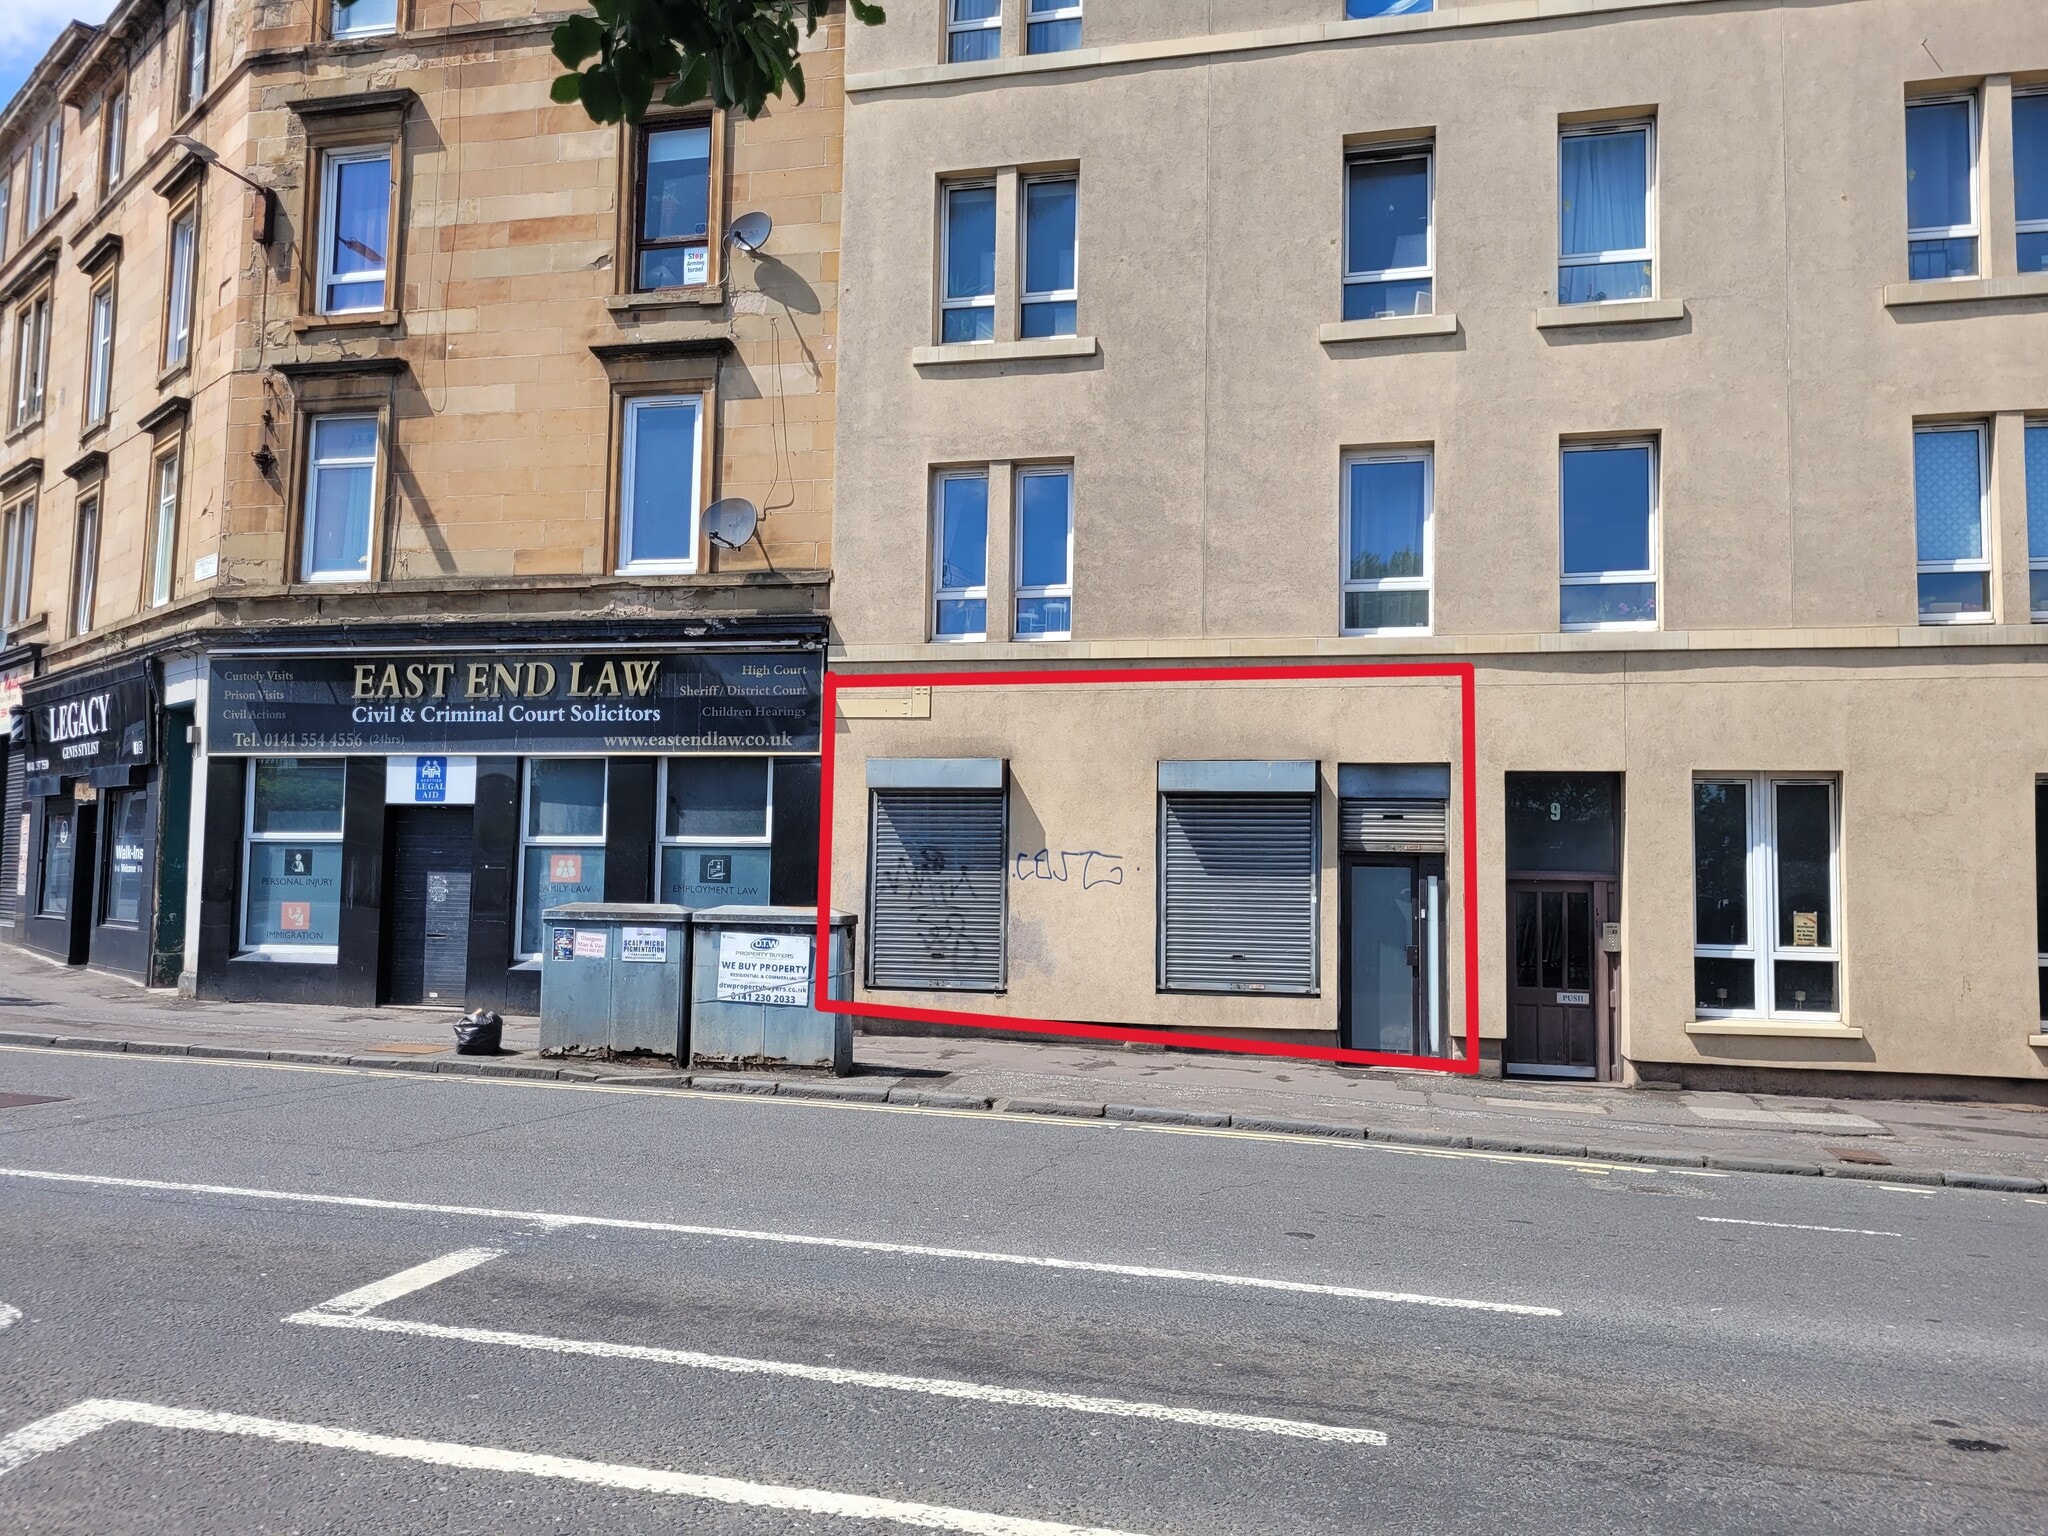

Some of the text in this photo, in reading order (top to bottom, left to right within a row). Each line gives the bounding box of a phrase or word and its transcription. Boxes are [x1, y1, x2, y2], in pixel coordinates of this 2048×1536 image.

[224, 670, 295, 682] Custody Visits
[741, 664, 808, 677] High Court
[352, 660, 661, 699] EAST END LAW
[223, 689, 285, 700] Prison Visits
[679, 684, 719, 697] Sheriff
[726, 685, 771, 696] District
[772, 685, 808, 696] Court
[49, 693, 111, 743] LEGACY
[222, 709, 287, 720] Civil Actions
[352, 704, 661, 723] Civil & Criminal Court Solicitors
[701, 706, 807, 719] Children Hearings
[233, 732, 405, 747] Tel. 0141 554 4556 (24hrs)
[603, 731, 793, 747] www.eastendlaw.co.uk
[62, 740, 100, 760] GENTS STYLIST
[416, 782, 446, 791] LEGAL
[422, 790, 440, 799] AID
[1550, 802, 1561, 821] 9
[115, 844, 144, 860] Walk-Ins
[261, 877, 334, 888] PERSONAL INJURY
[540, 884, 592, 894] FAMILY LAW
[672, 884, 759, 895] EMPLOYMENT LAW
[266, 931, 324, 940] IMMIGRATION
[580, 935, 603, 943] Glasgow
[623, 939, 643, 947] SCALP
[623, 945, 665, 953] PIGMENTATION
[735, 950, 769, 958] PROPERTY
[769, 951, 794, 959] BUYERS
[721, 961, 807, 974] WE BUY PROPERTY
[730, 992, 796, 1004] 0141 230 2033
[1562, 994, 1585, 1002] PUSH
